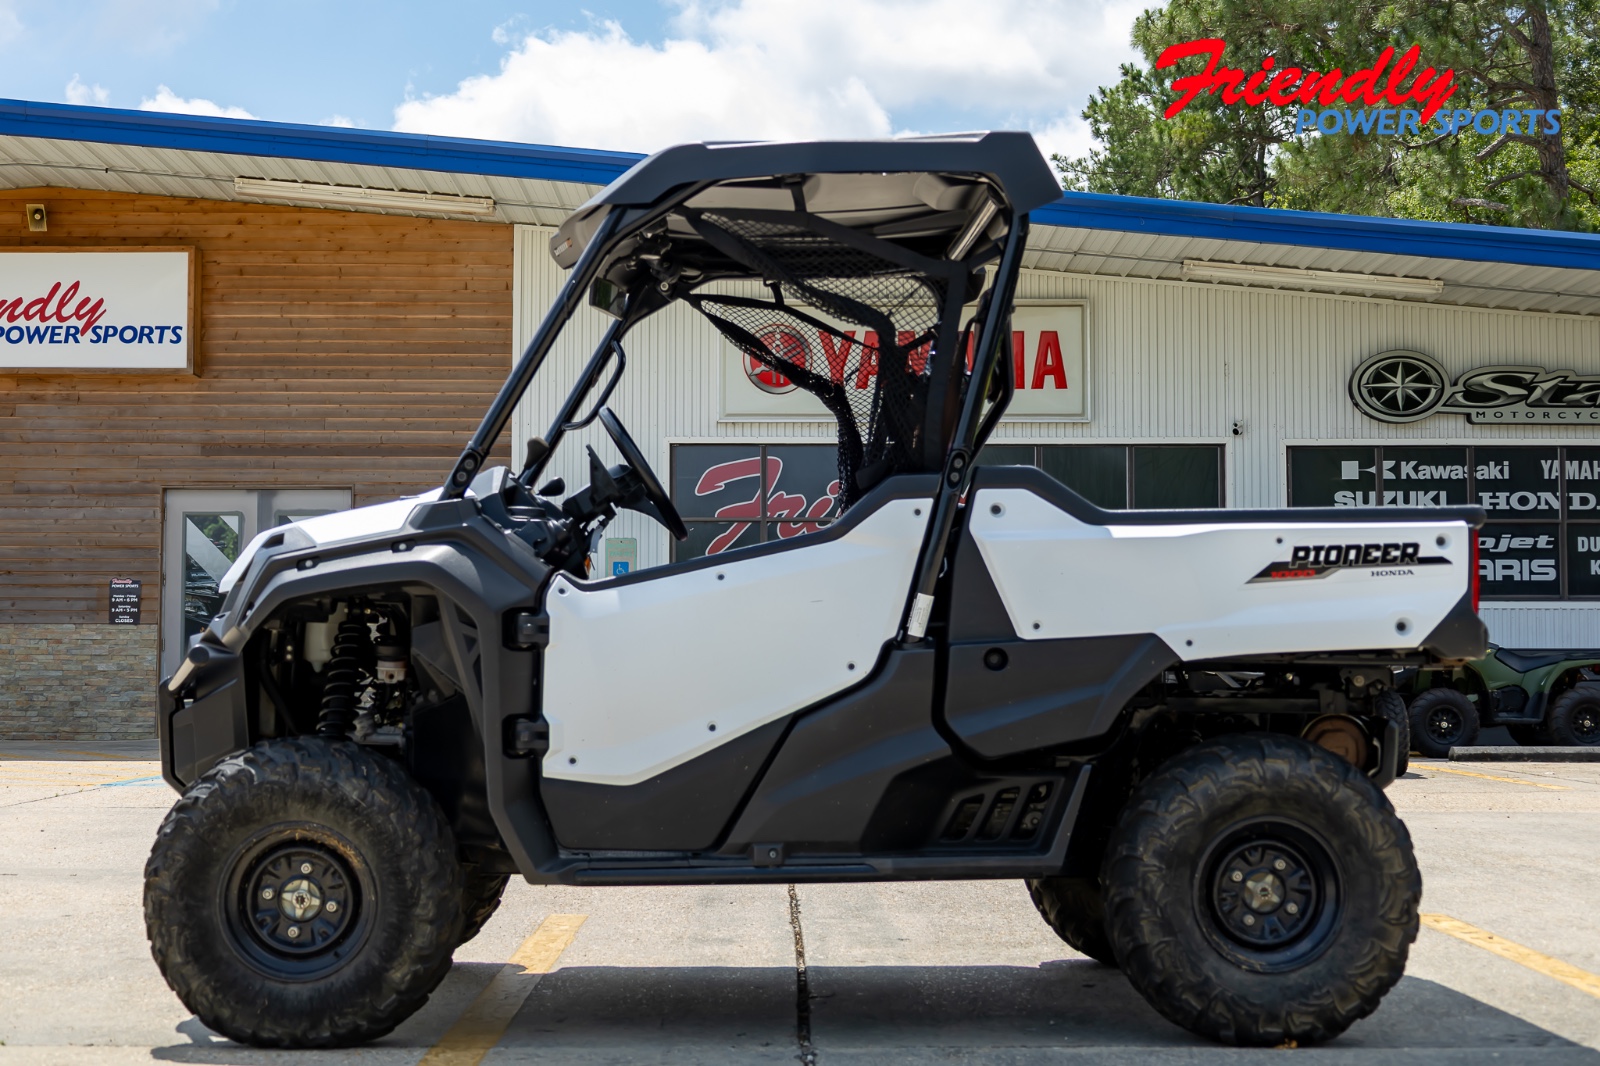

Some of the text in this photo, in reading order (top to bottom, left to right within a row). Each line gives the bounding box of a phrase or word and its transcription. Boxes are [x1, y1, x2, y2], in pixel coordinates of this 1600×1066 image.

[89, 325, 183, 345] SPORTS
[818, 331, 1068, 390] YAA
[1476, 411, 1599, 419] MOTORCYC
[695, 456, 848, 556] Fri
[1334, 490, 1447, 507] SUZUKI
[1478, 491, 1600, 510] HOND
[1289, 542, 1420, 568] PIONEER
[1271, 569, 1316, 579] 1000
[1370, 569, 1415, 577] HONDA
